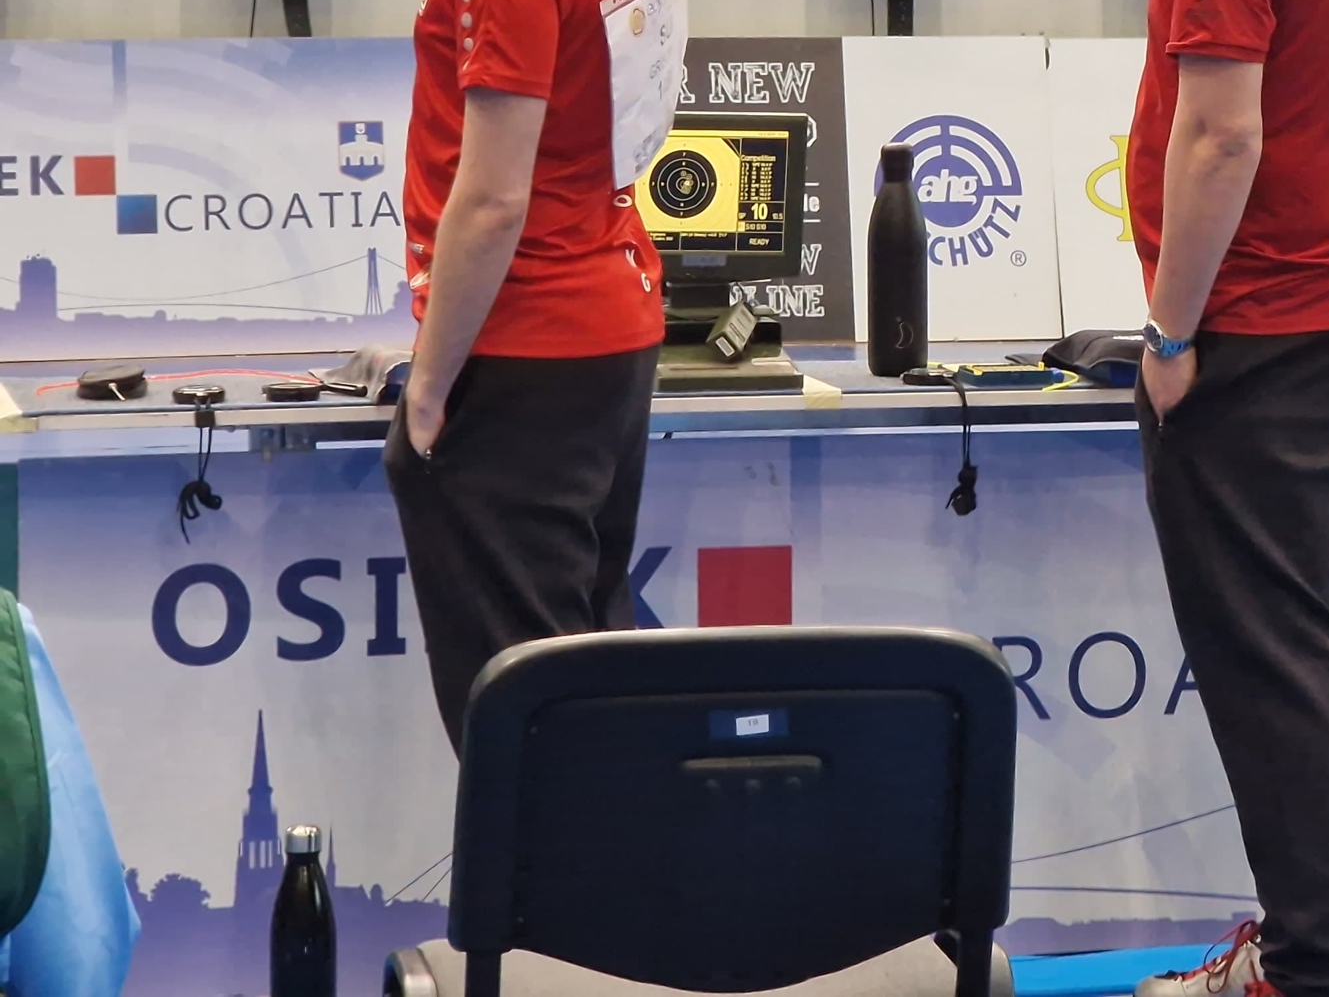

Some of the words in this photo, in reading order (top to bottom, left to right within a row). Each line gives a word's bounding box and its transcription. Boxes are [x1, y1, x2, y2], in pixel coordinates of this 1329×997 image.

[708, 62, 815, 103] NEW
[917, 168, 979, 206] ahg
[164, 190, 402, 233] CROATIA
[750, 203, 768, 220] 10
[749, 237, 770, 246] READY
[925, 197, 1022, 267] CHÜTZ
